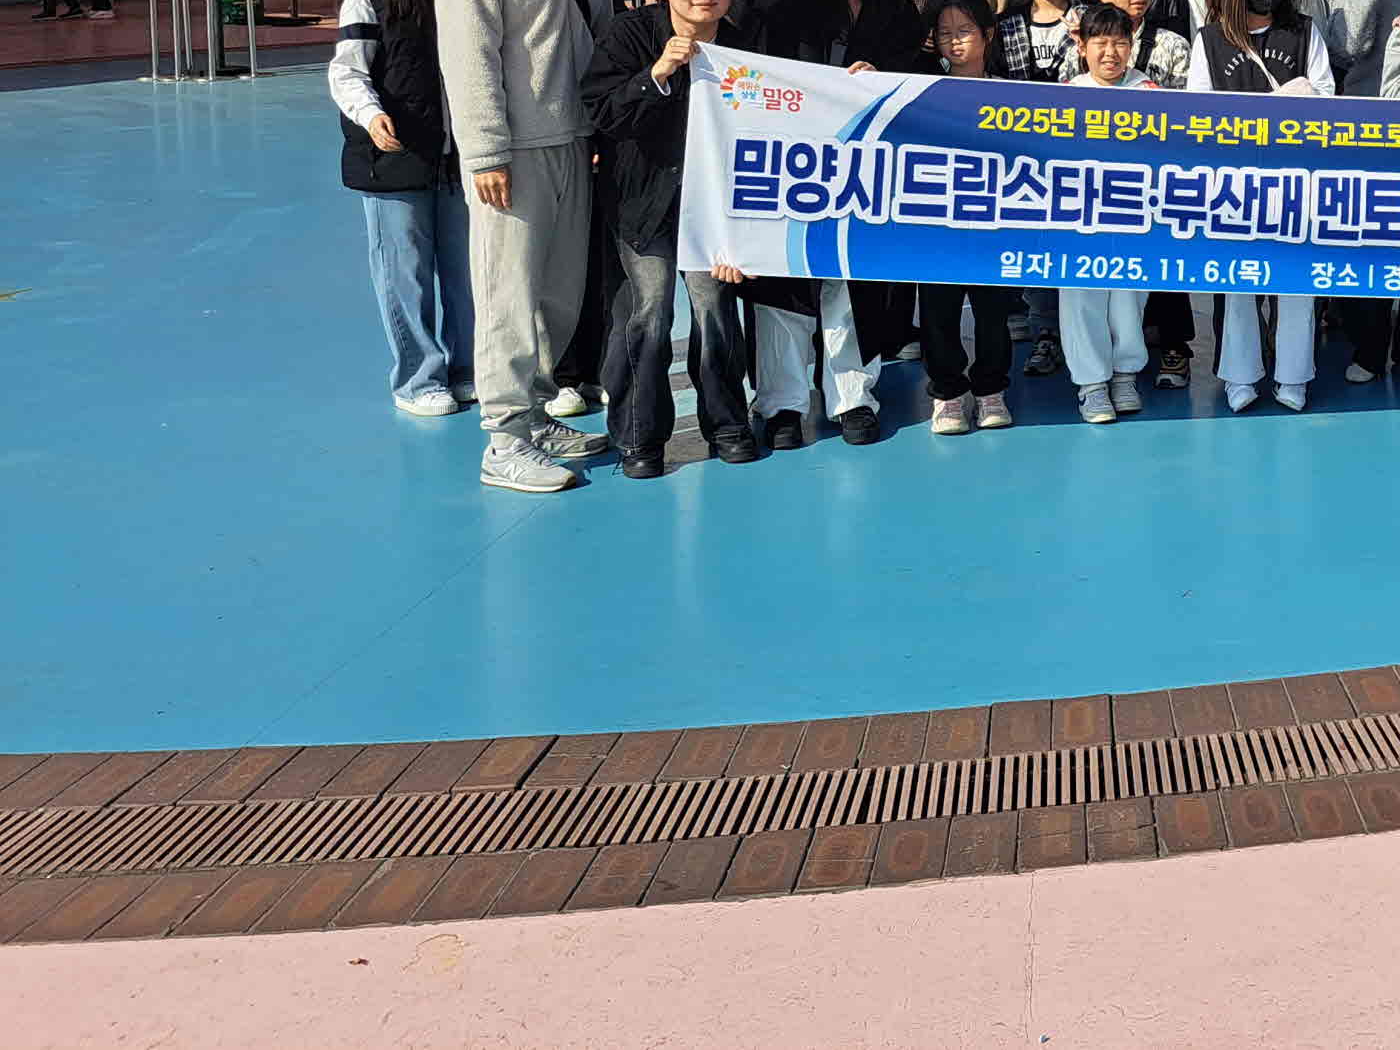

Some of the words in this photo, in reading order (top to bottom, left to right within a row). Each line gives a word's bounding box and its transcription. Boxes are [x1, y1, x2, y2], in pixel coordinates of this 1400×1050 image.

[763, 87, 804, 112] 밀양
[978, 106, 1076, 138] 2025년
[1085, 110, 1269, 146] 밀양시-부산대
[732, 138, 887, 218] 밀양시
[1000, 251, 1053, 279] 일자
[1075, 255, 1149, 281] 2025.
[1160, 258, 1197, 283] 11.
[1311, 261, 1360, 290] 장소
